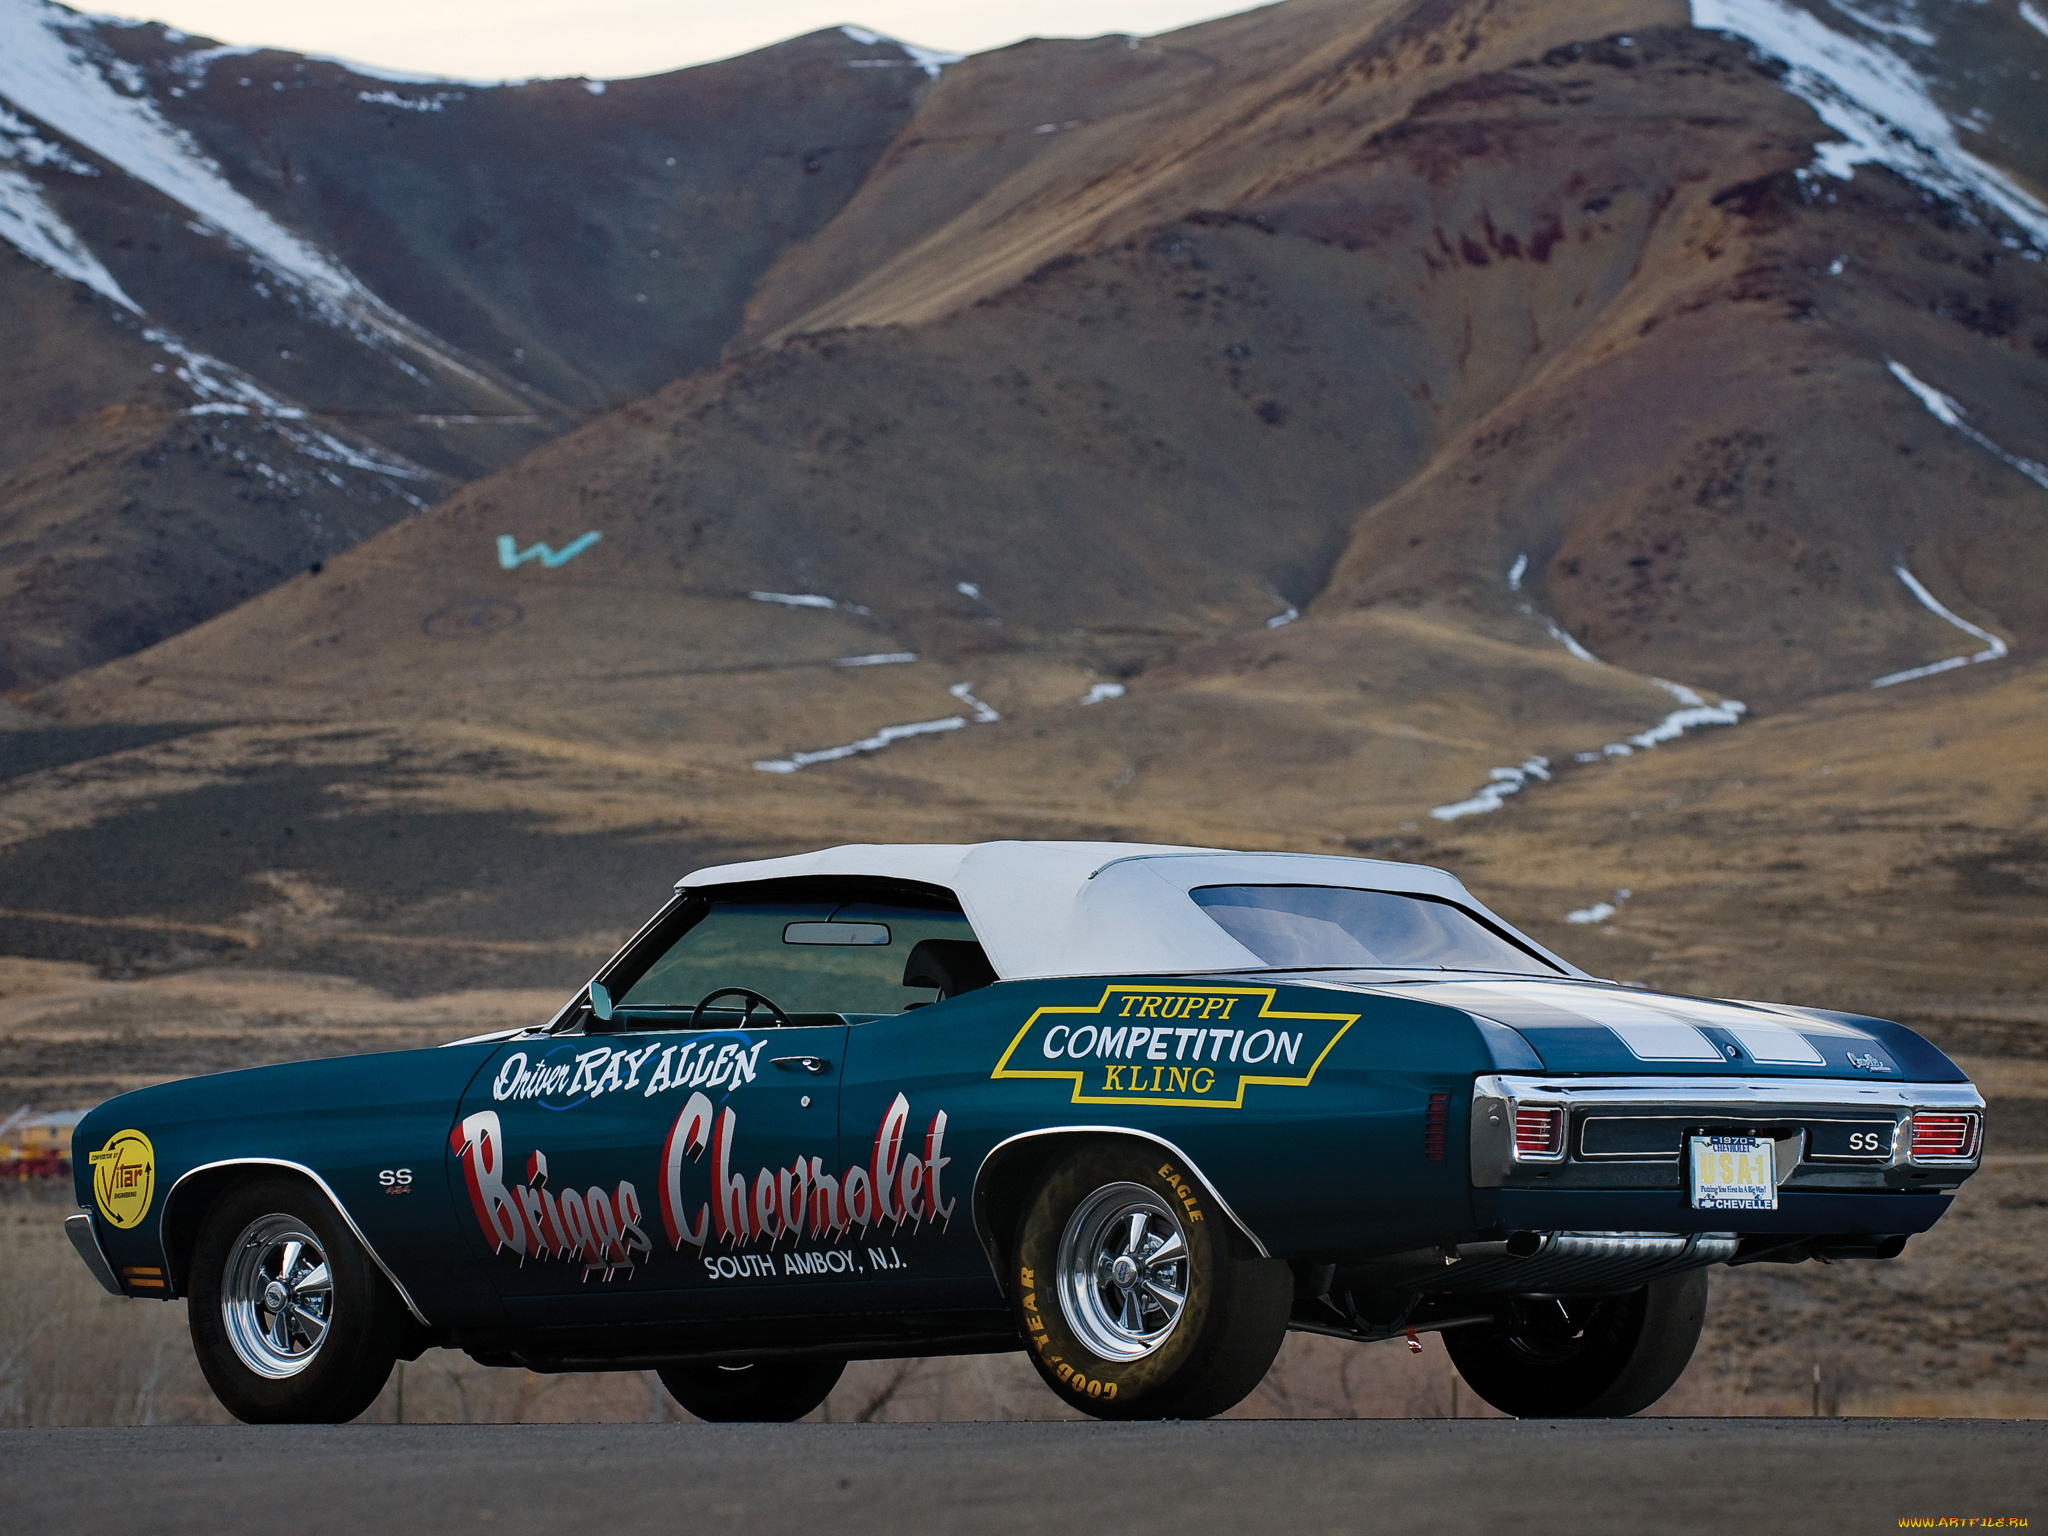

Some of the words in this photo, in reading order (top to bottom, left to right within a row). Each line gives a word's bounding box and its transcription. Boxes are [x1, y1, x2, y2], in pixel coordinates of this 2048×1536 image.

[1119, 995, 1239, 1020] TRUPPI
[1042, 1025, 1304, 1065] COMPETITION
[494, 1052, 571, 1101] Driver
[566, 1045, 661, 1098] RAY
[644, 1040, 767, 1097] ALLEN
[1102, 1065, 1215, 1094] KLING
[1712, 1144, 1751, 1153] CHEVROLET
[1849, 1133, 1879, 1151] SS
[101, 1147, 143, 1207] Vitar
[379, 1168, 413, 1186] SS
[1700, 1153, 1764, 1184] USA-1
[450, 1110, 652, 1284] Briggs
[658, 1091, 957, 1259] Chevrolet
[1157, 1163, 1204, 1223] EAGLE
[1700, 1185, 1718, 1195] Putting
[1715, 1200, 1772, 1209] CHEVELLE
[703, 1254, 776, 1280] SOUTH
[785, 1249, 864, 1278] AMBOY,
[868, 1246, 908, 1271] N.J.
